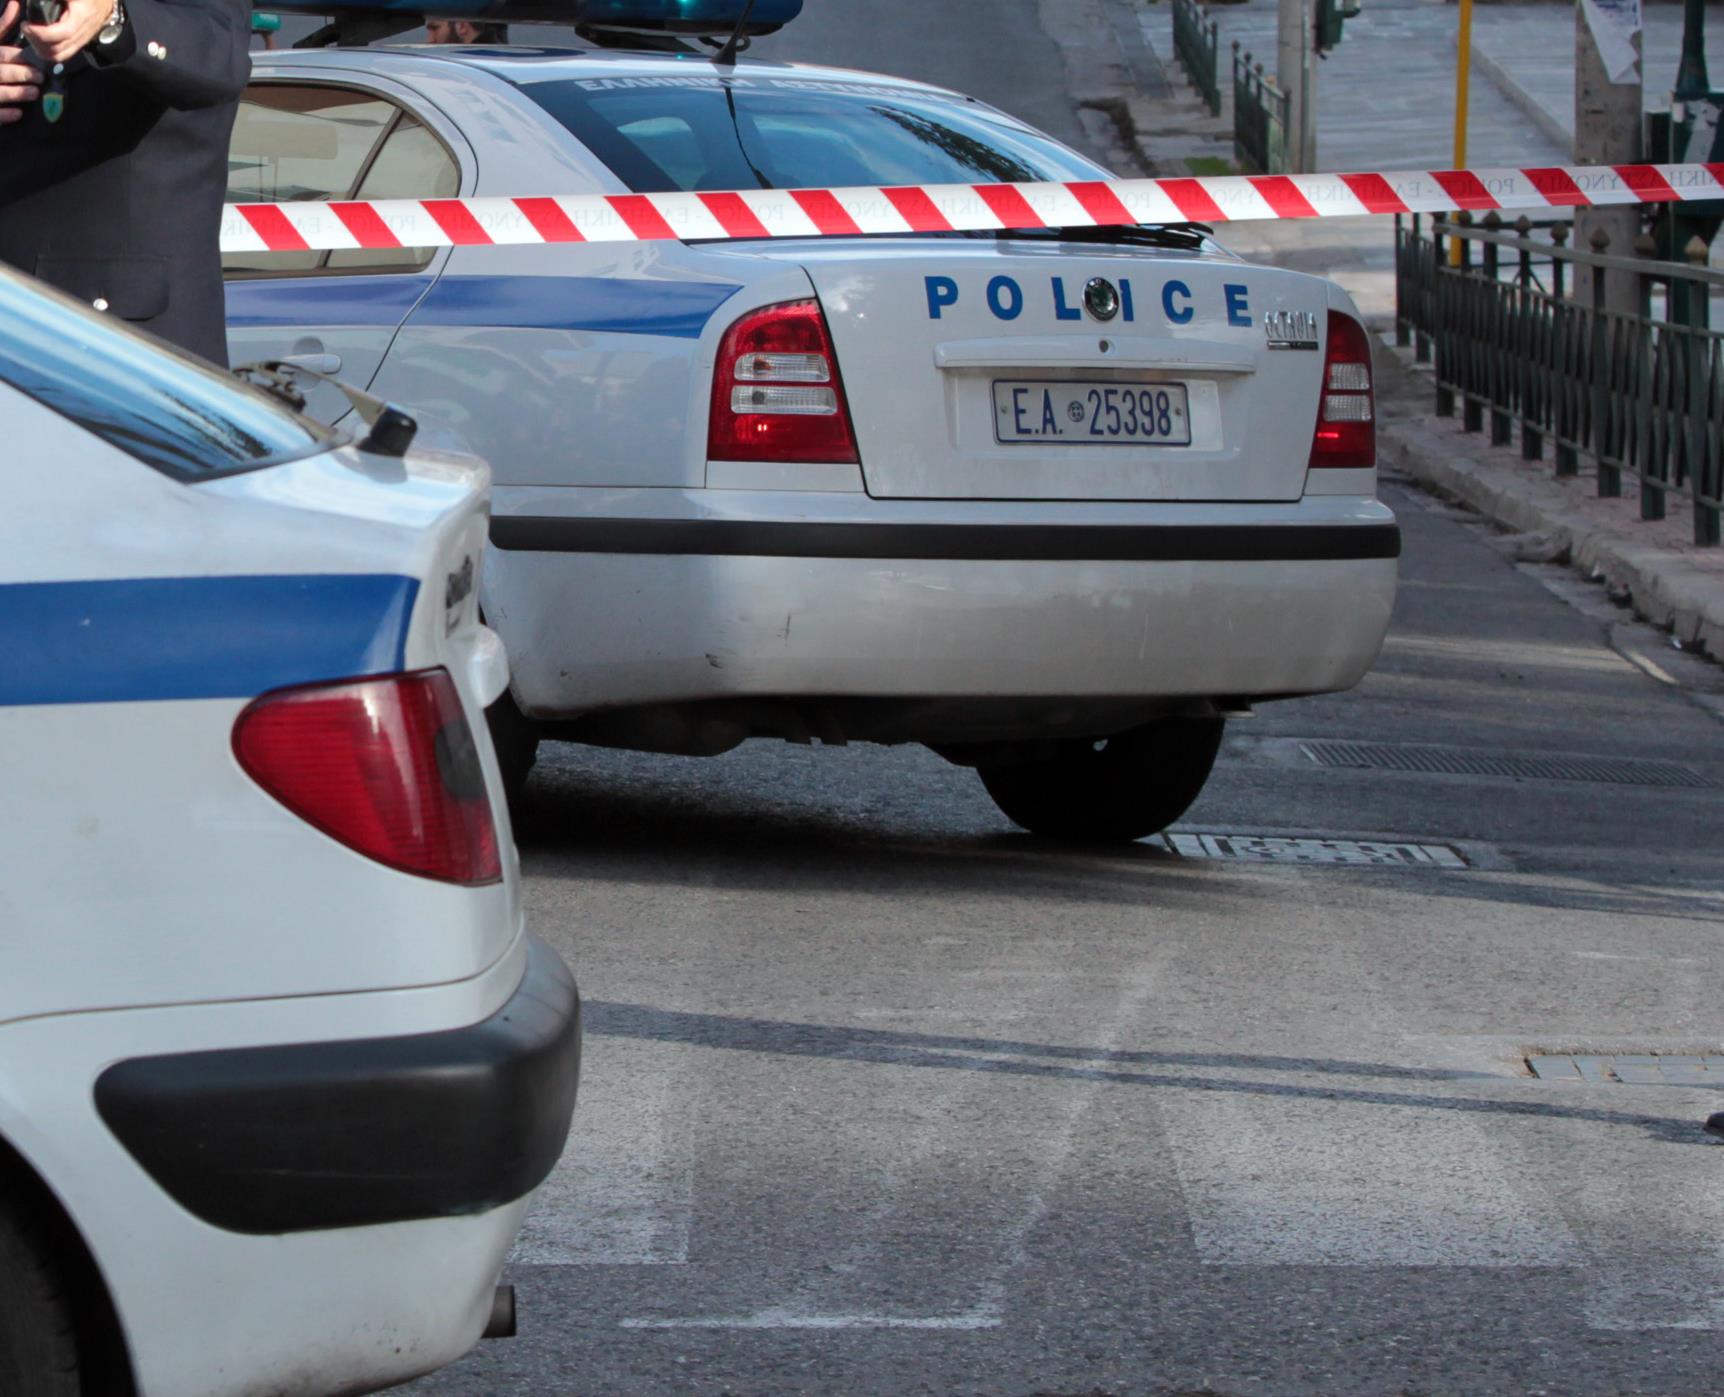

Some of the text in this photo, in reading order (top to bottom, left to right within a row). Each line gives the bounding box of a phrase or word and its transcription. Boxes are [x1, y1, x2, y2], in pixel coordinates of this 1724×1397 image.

[924, 275, 1253, 327] POLICE
[1264, 311, 1318, 340] OCTAVIA
[1088, 389, 1172, 436] 25398
